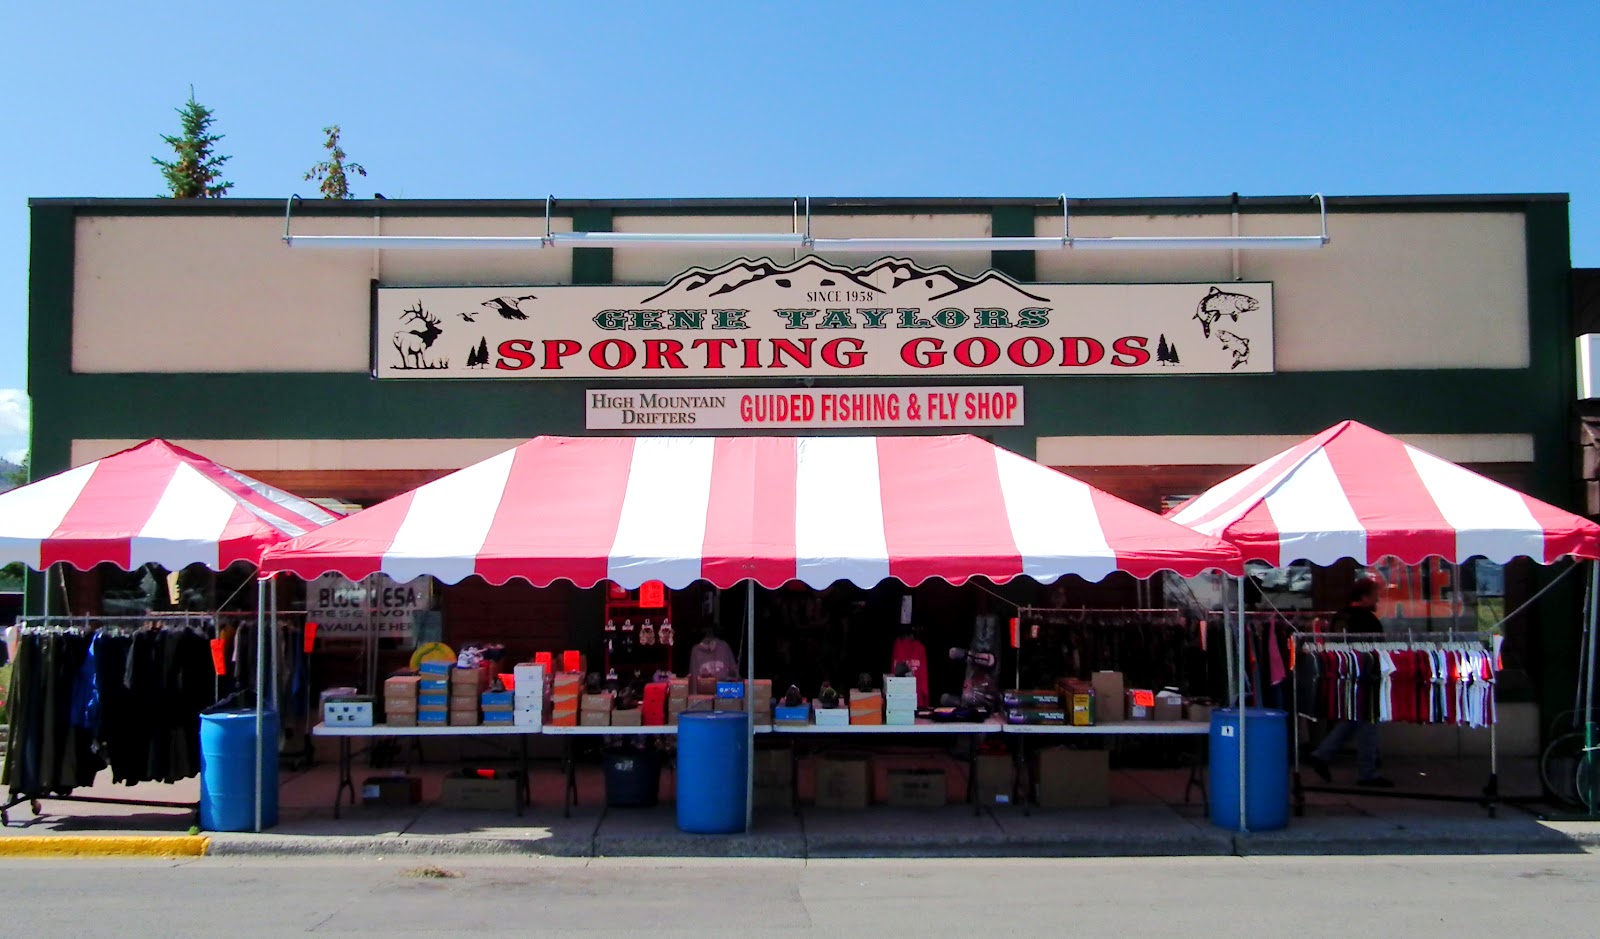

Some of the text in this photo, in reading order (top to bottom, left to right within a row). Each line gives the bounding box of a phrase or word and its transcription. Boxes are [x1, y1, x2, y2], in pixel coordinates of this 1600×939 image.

[807, 290, 873, 303] SINCE 1958
[592, 307, 1053, 331] GENE TAYLORS
[495, 336, 1151, 371] SPORTING GOODS
[591, 393, 726, 409] HIGH MOUNTAIN
[740, 392, 1018, 422] GUIDED FISHING & FLY SHOP
[621, 409, 697, 425] DRIFTERS
